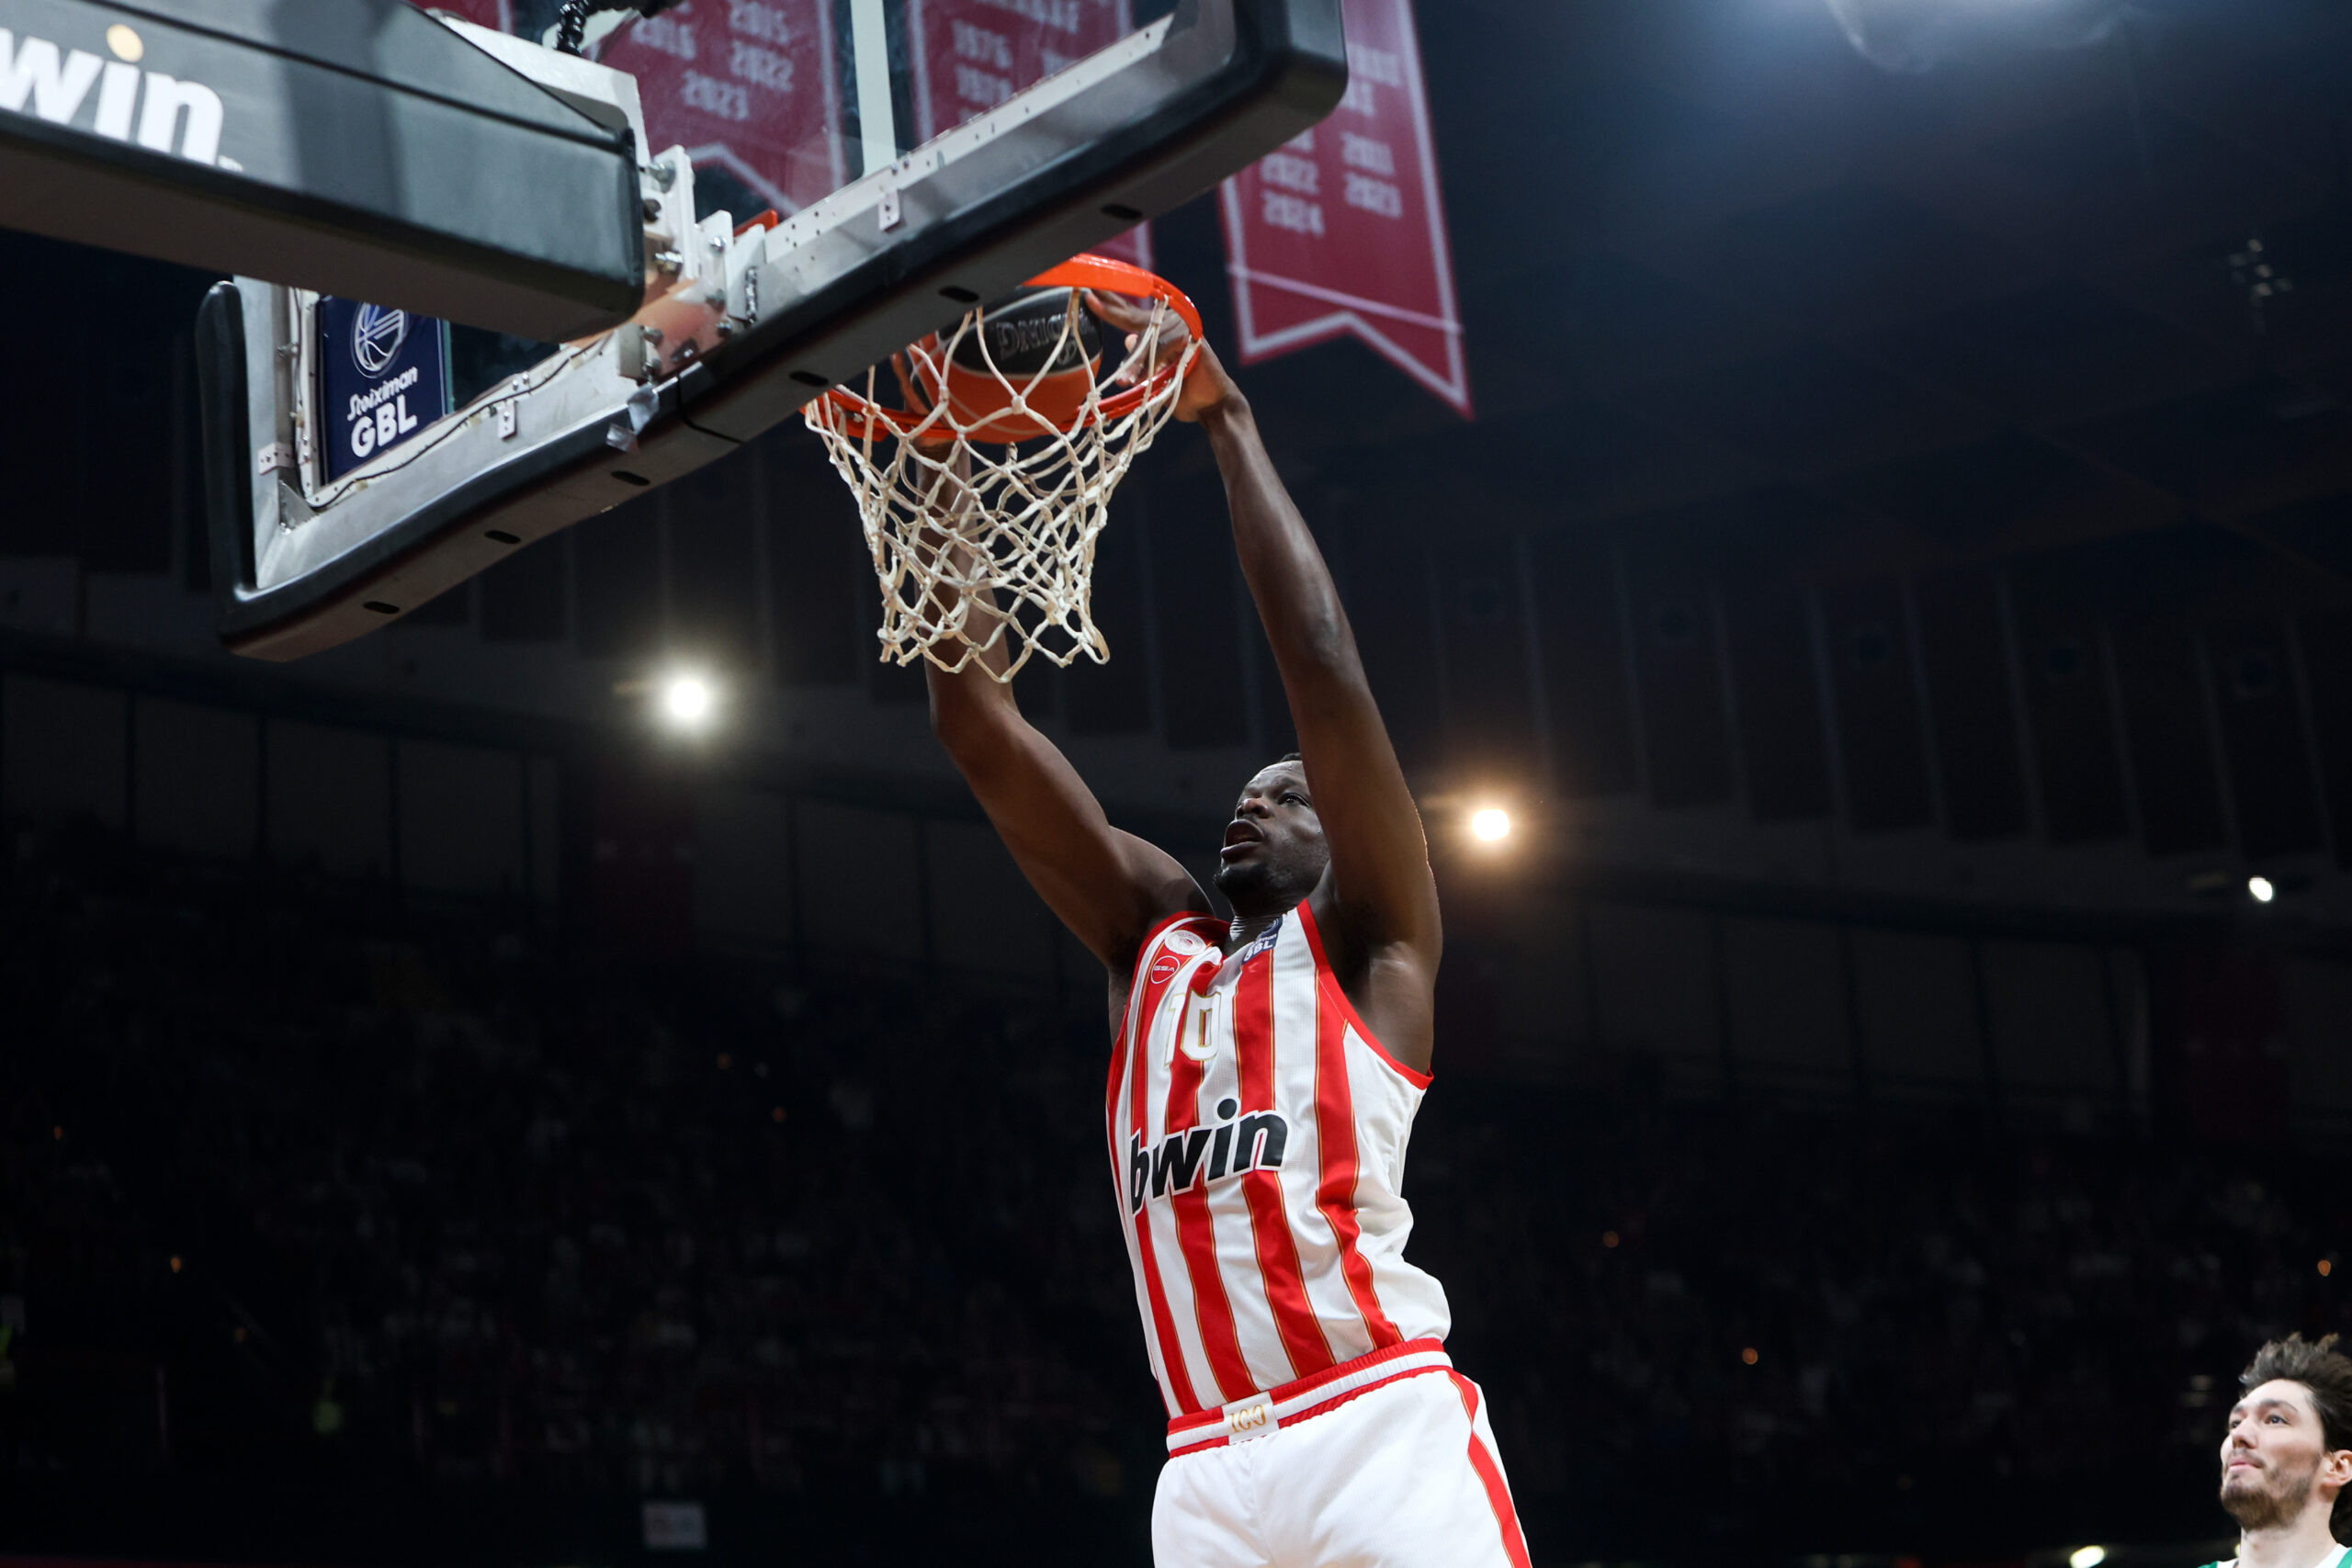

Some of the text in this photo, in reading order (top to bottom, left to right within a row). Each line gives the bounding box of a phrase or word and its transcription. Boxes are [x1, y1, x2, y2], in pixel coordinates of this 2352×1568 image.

[347, 367, 418, 422] Stoiximan
[351, 394, 418, 457] GBL
[1164, 988, 1222, 1066] 10
[1131, 1097, 1289, 1214] bwin
